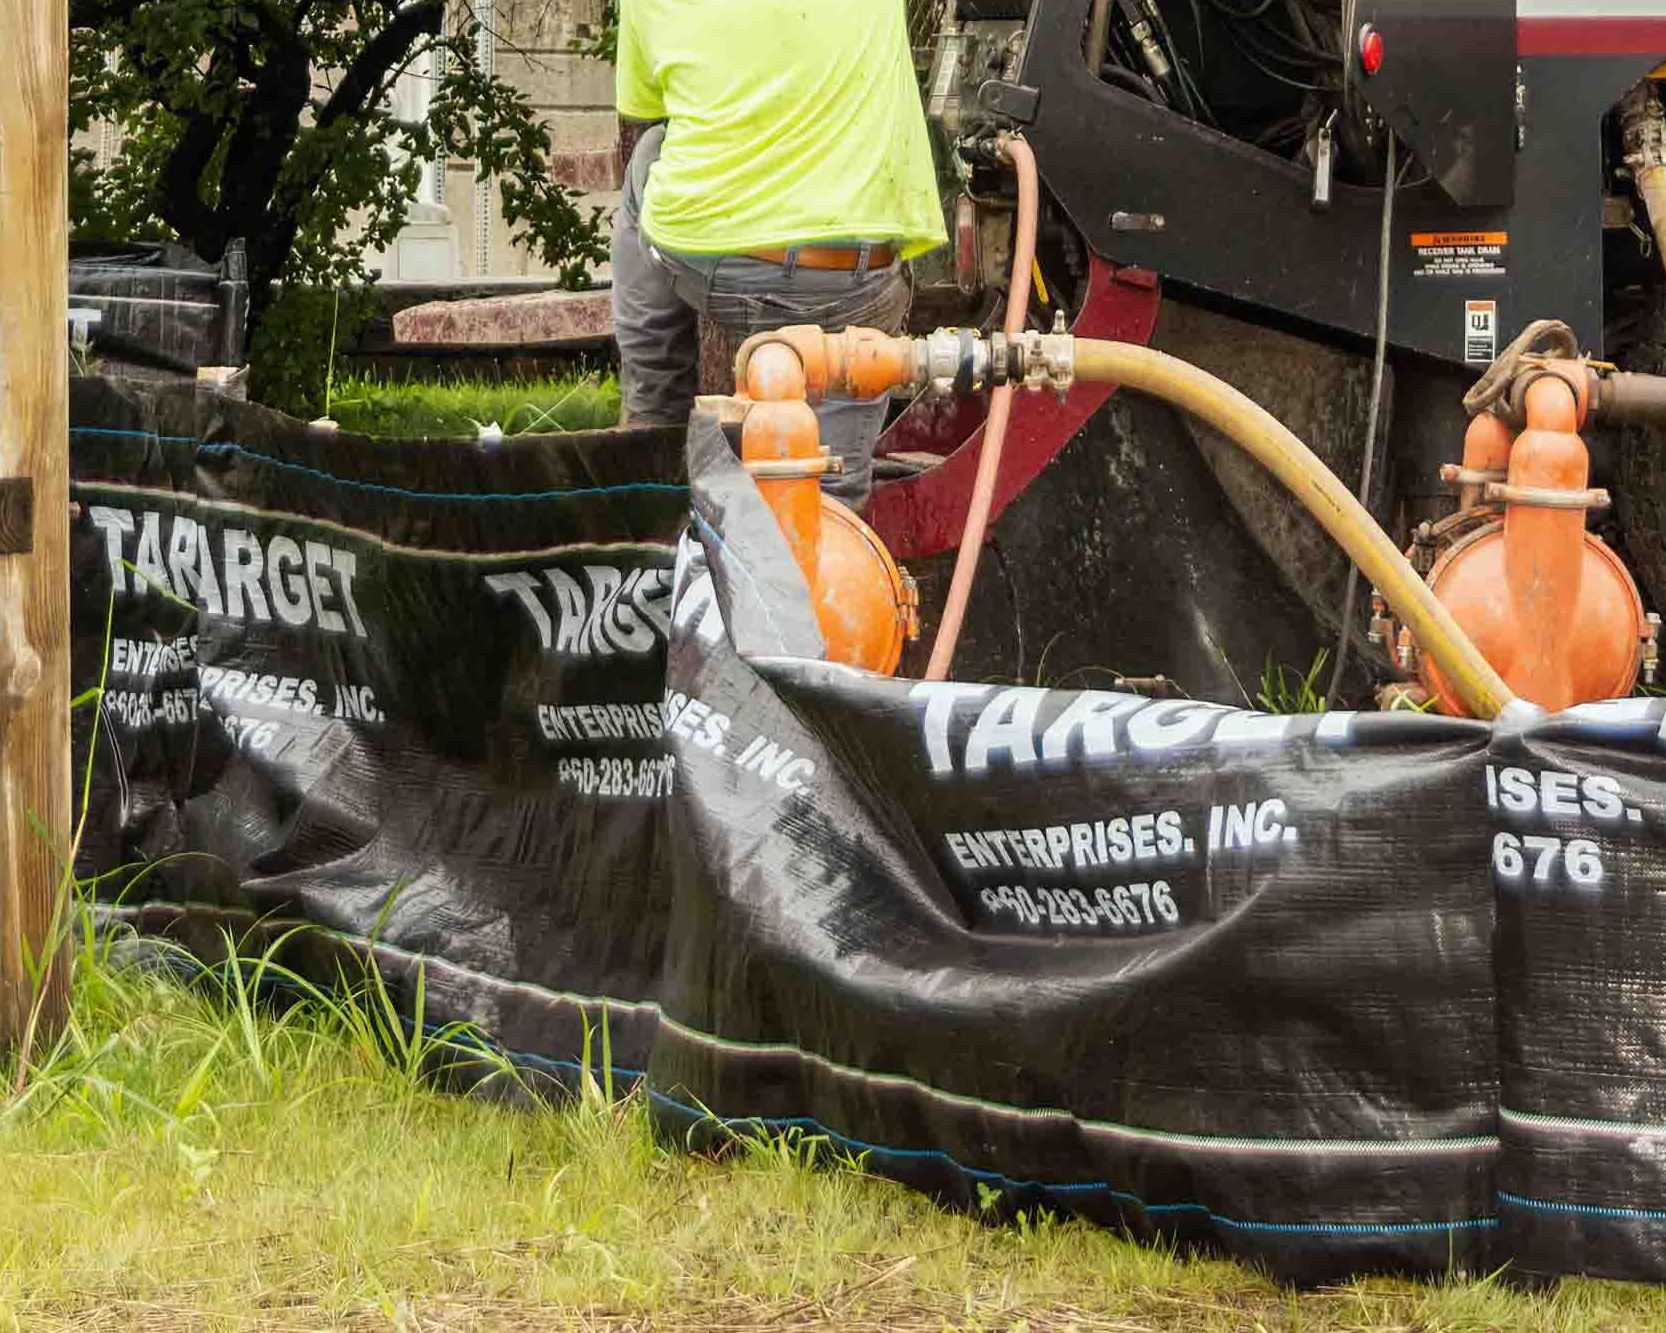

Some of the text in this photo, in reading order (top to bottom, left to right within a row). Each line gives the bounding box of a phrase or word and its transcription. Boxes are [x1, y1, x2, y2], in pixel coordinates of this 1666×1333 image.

[197, 663, 386, 722] PRISES. INC.
[734, 734, 815, 796] INC.
[1485, 764, 1643, 823] ISES.
[944, 798, 1299, 870] ENTERPRISES. INC.
[1491, 832, 1604, 883] 676
